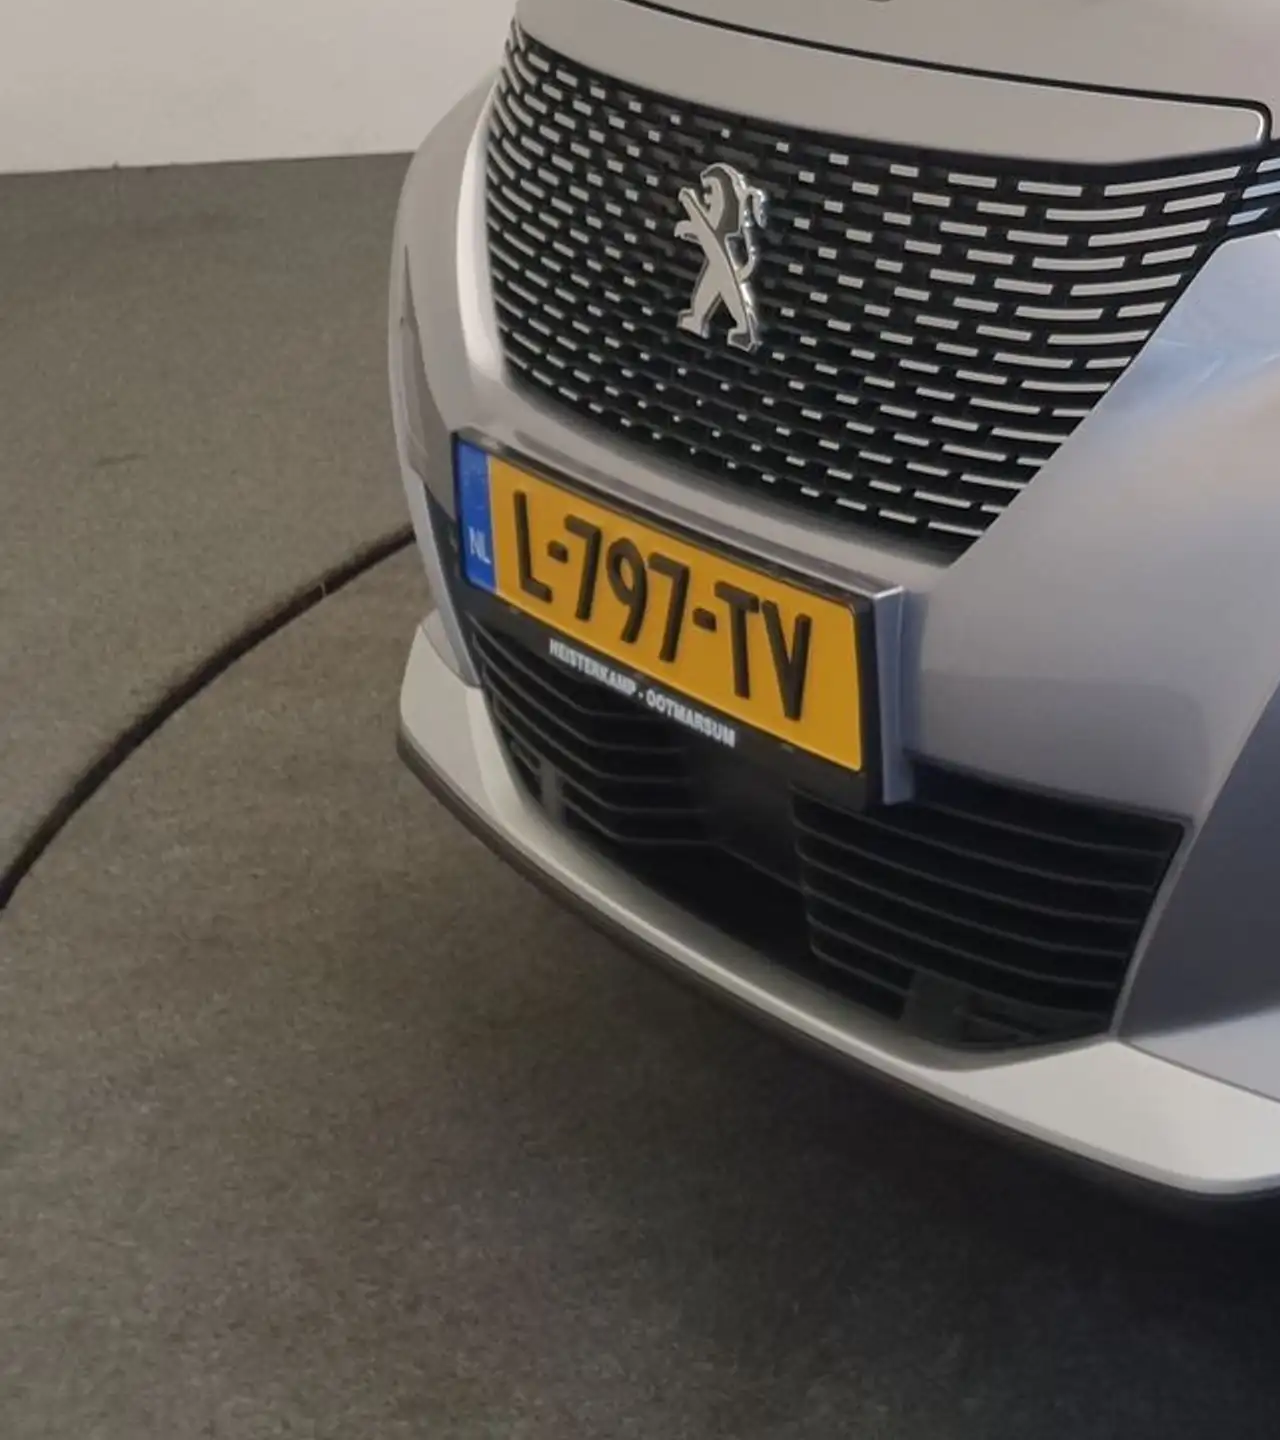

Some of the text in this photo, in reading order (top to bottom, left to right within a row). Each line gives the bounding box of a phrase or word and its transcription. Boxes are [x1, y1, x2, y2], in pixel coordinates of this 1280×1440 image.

[469, 527, 490, 565] NL
[513, 491, 812, 721] L-797-TV
[549, 638, 736, 748] HEISTERKAMP OOTMARSUM
